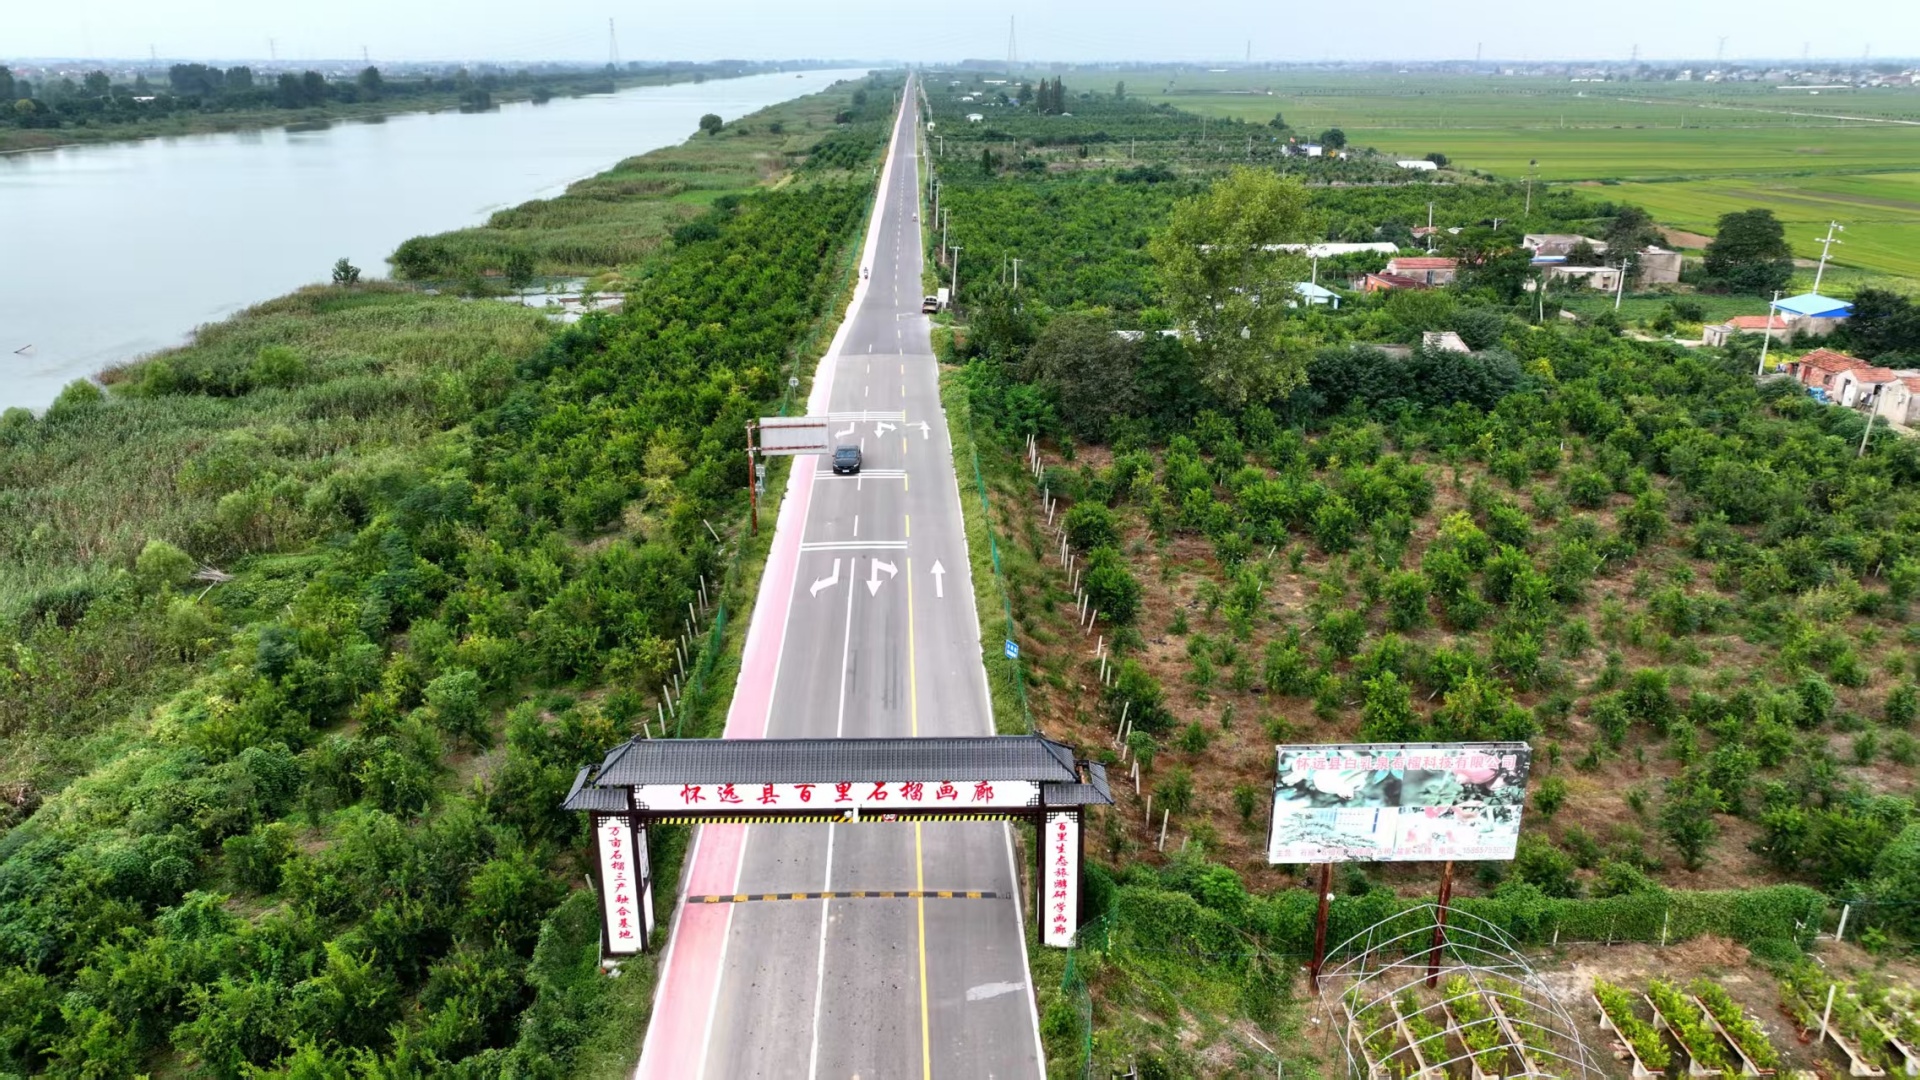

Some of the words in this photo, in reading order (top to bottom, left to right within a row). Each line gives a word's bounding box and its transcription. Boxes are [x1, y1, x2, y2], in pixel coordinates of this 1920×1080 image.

[1296, 754, 1517, 771] 怀远县白乳泉石榴科技有限公司
[680, 780, 995, 805] 怀远县百里石榴画廊
[607, 826, 634, 939] 万亩石榴三产融合基地
